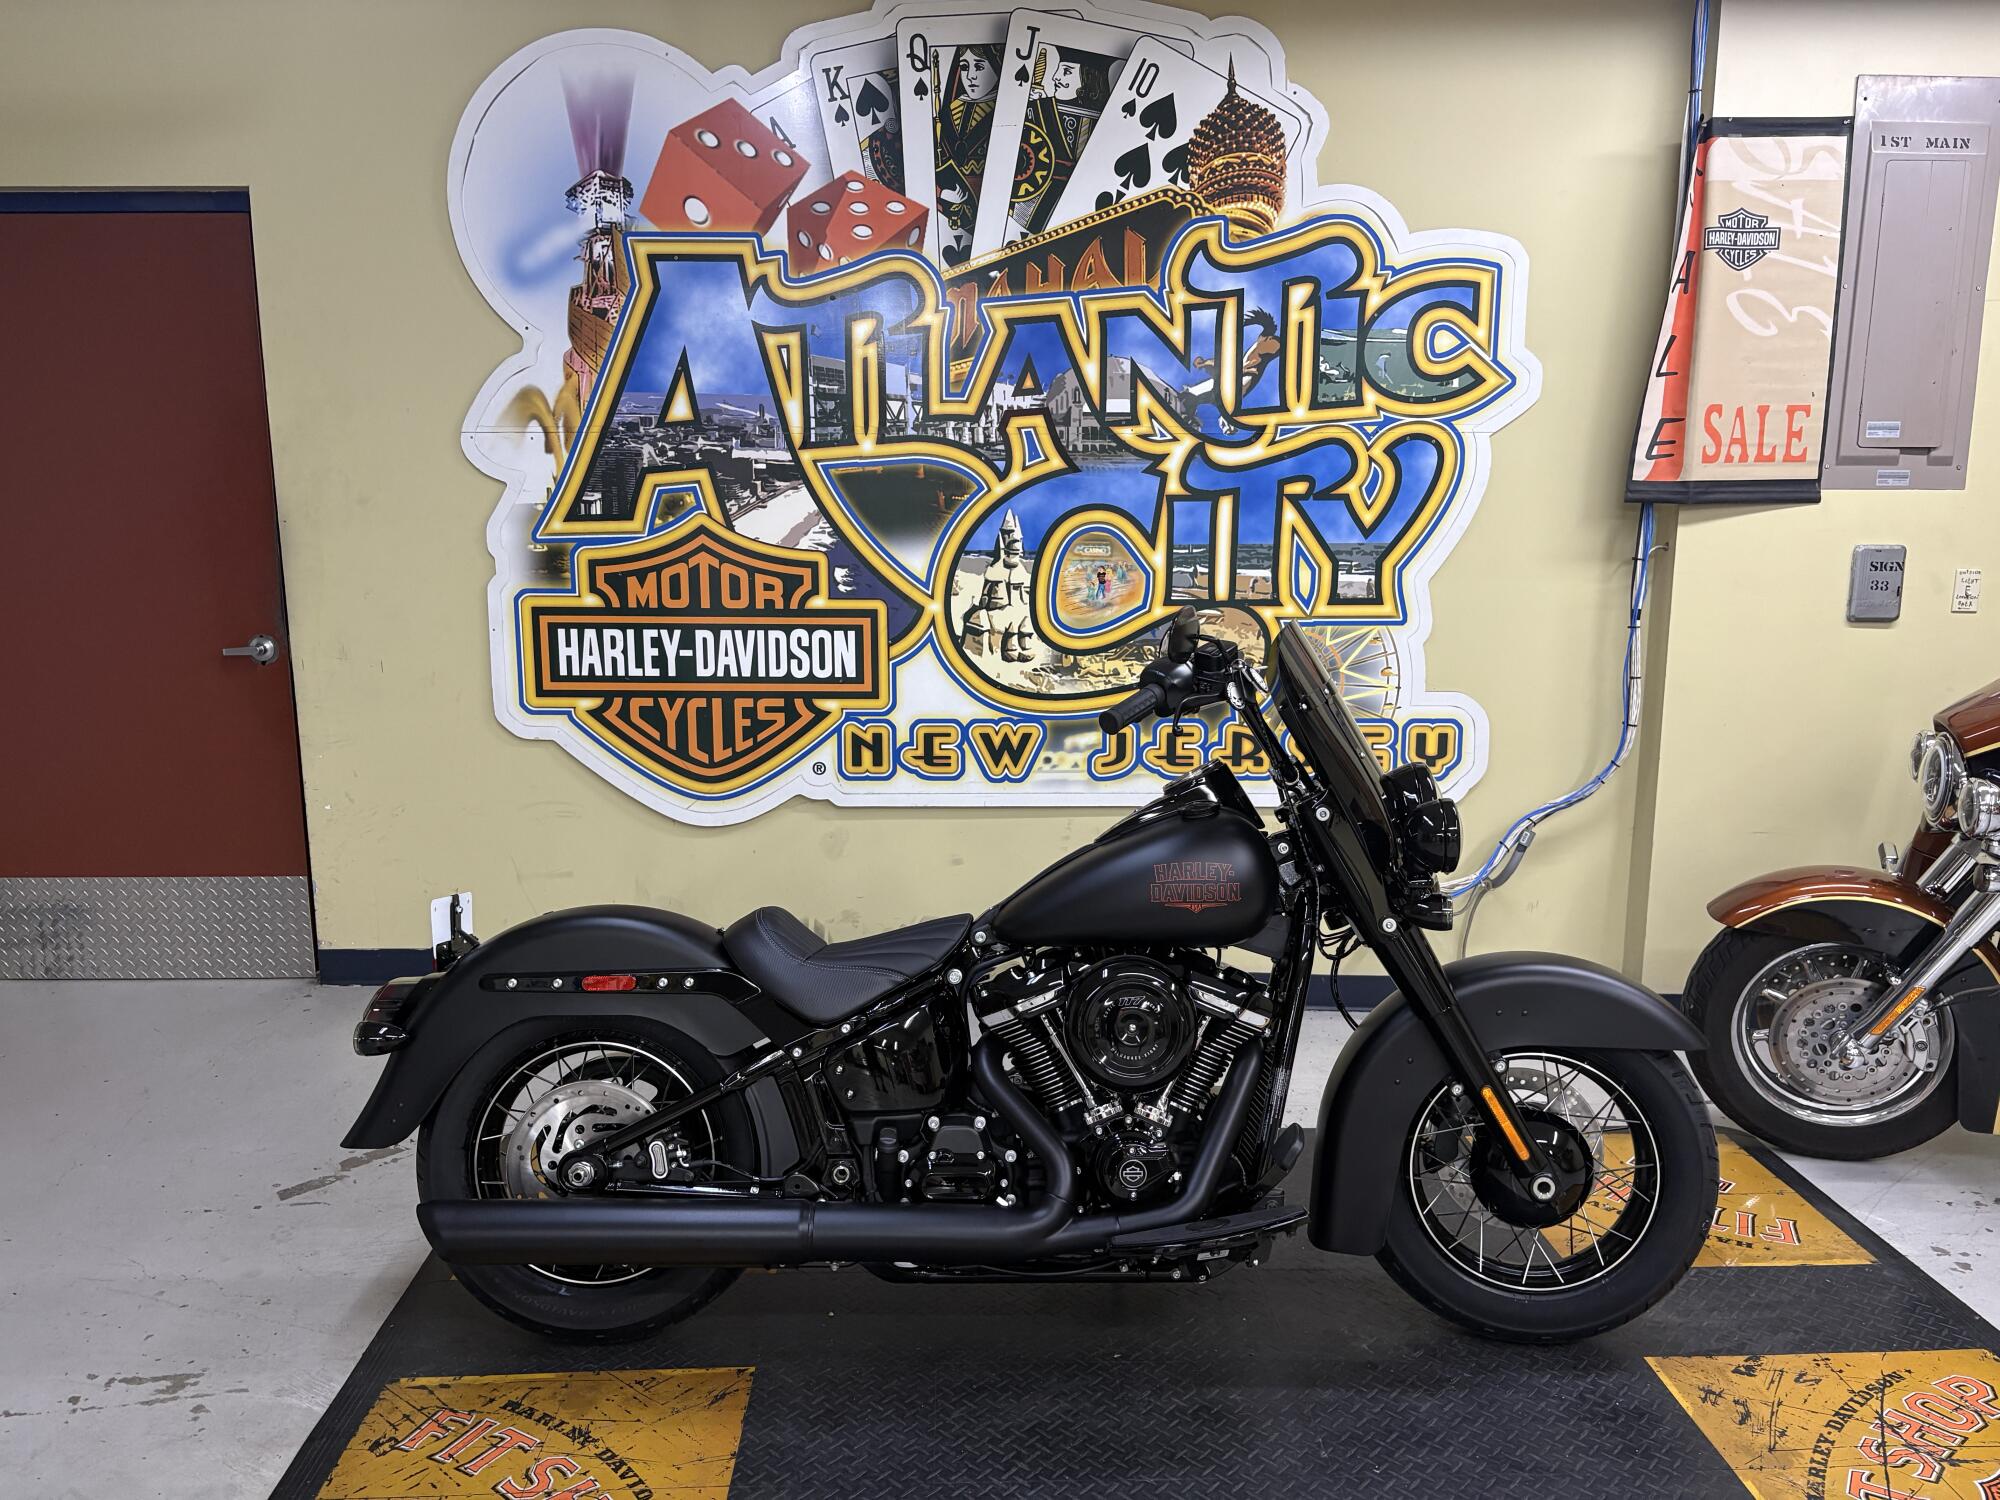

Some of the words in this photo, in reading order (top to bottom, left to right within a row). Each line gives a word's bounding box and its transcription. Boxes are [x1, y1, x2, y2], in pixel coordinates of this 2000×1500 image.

[1880, 135, 1912, 148] 1ST
[1925, 137, 1971, 150] MAIN
[1708, 231, 1776, 246] HARLEY-DAVIDSON
[1725, 213, 1759, 229] MOTOR
[1724, 250, 1758, 267] CYCLES
[538, 215, 1518, 537] ATLANTIC
[1701, 403, 1812, 464] SALE
[626, 551, 785, 609] MOTOR
[940, 410, 1460, 710] CITY
[1869, 561, 1904, 572] SIGN
[1870, 580, 1889, 591] 33
[557, 628, 857, 679] HARLEY-DAVIDSON
[629, 697, 786, 763] CYCLES
[847, 726, 1038, 774] NEW
[1095, 725, 1455, 774] JERY
[1150, 882, 1241, 902] DAVIDSON
[395, 1407, 541, 1477] FIT
[1857, 1375, 2000, 1483] SHOP
